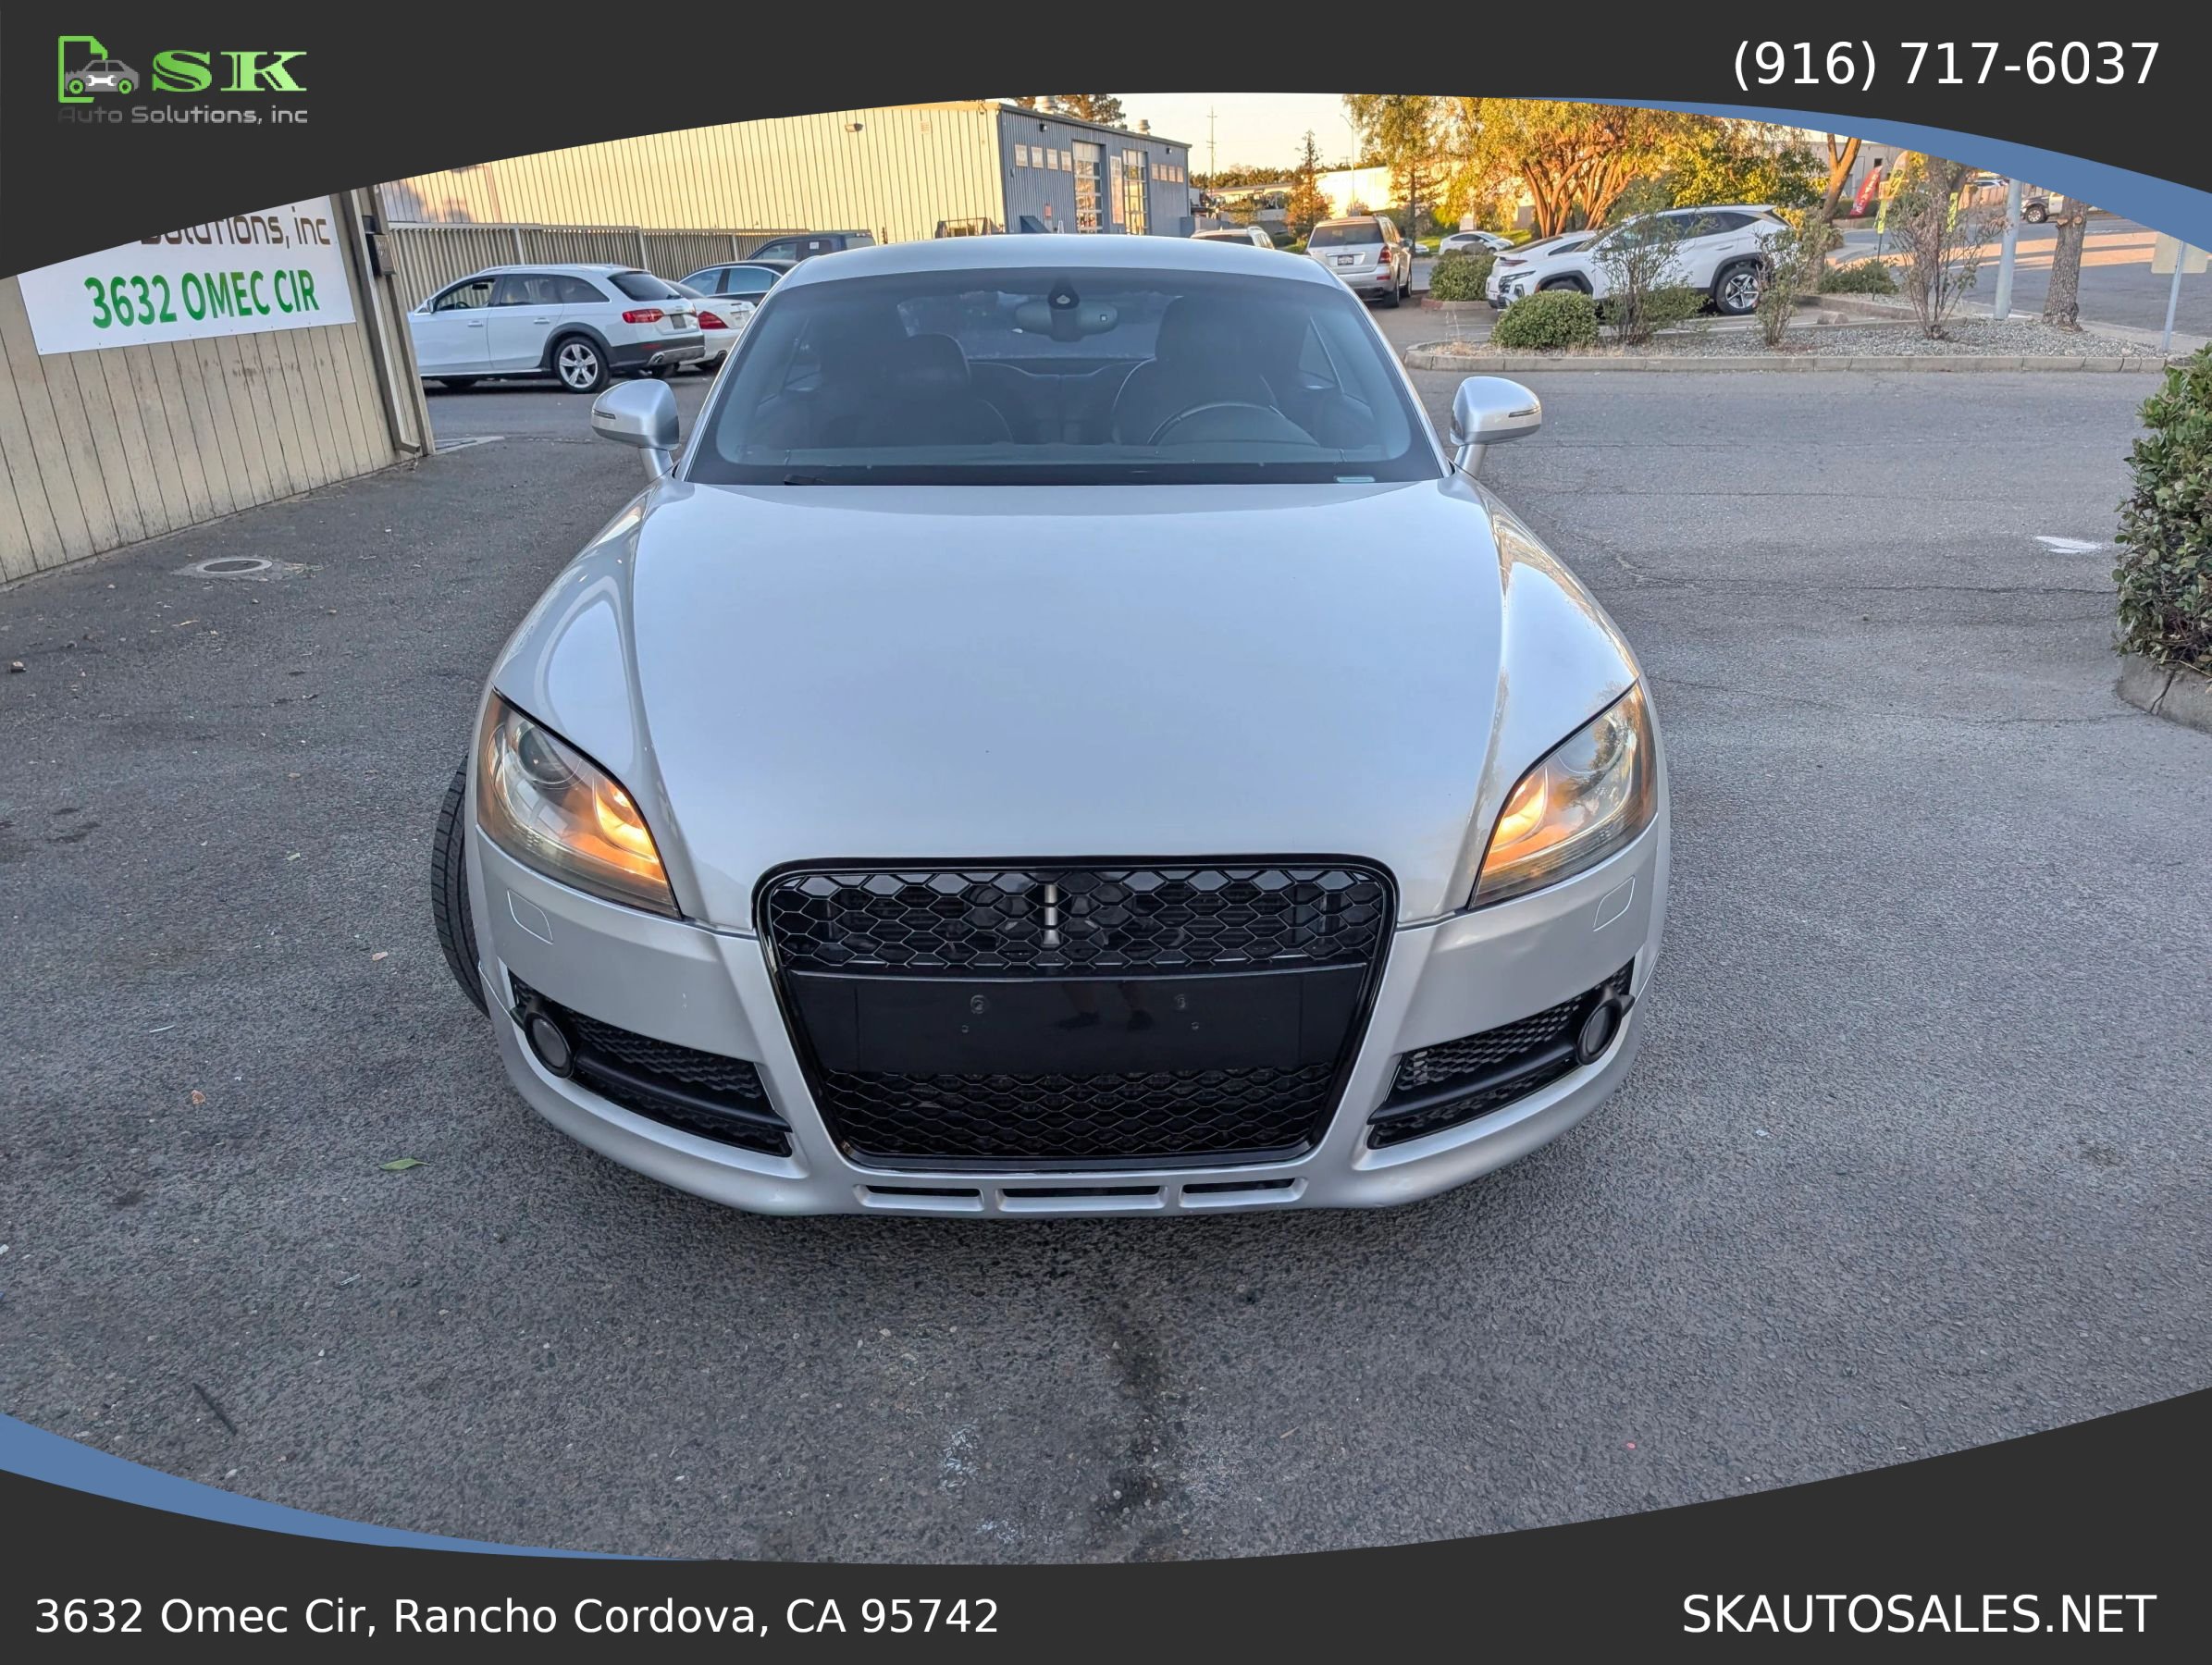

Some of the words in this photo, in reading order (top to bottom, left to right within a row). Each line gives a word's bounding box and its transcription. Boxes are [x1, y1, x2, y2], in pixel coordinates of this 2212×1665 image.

[291, 206, 330, 245] inc
[84, 275, 178, 328] 3632
[181, 269, 271, 321] OMEC
[274, 269, 320, 314] CIR
